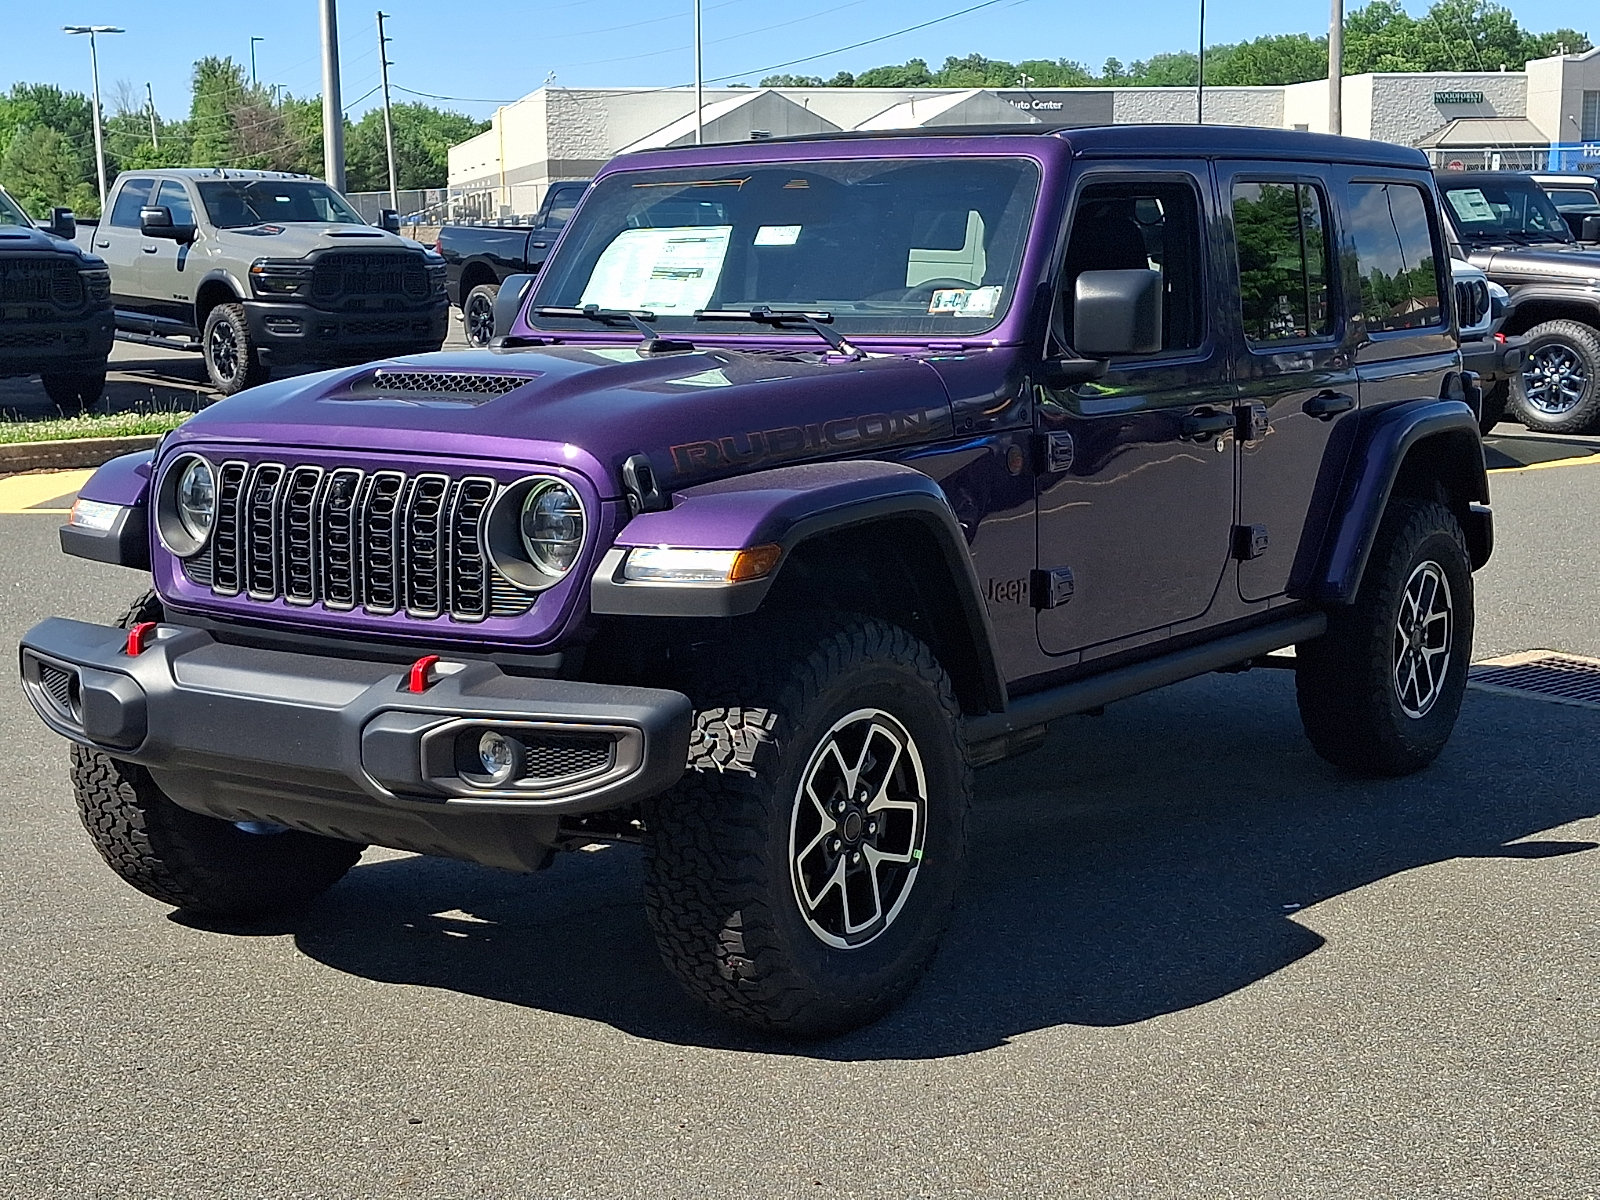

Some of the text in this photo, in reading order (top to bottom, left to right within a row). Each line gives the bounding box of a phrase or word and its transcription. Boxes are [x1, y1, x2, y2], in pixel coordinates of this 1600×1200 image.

[1031, 100, 1063, 109] Center
[669, 409, 931, 473] RUBICON
[986, 577, 1027, 604] Jeep
